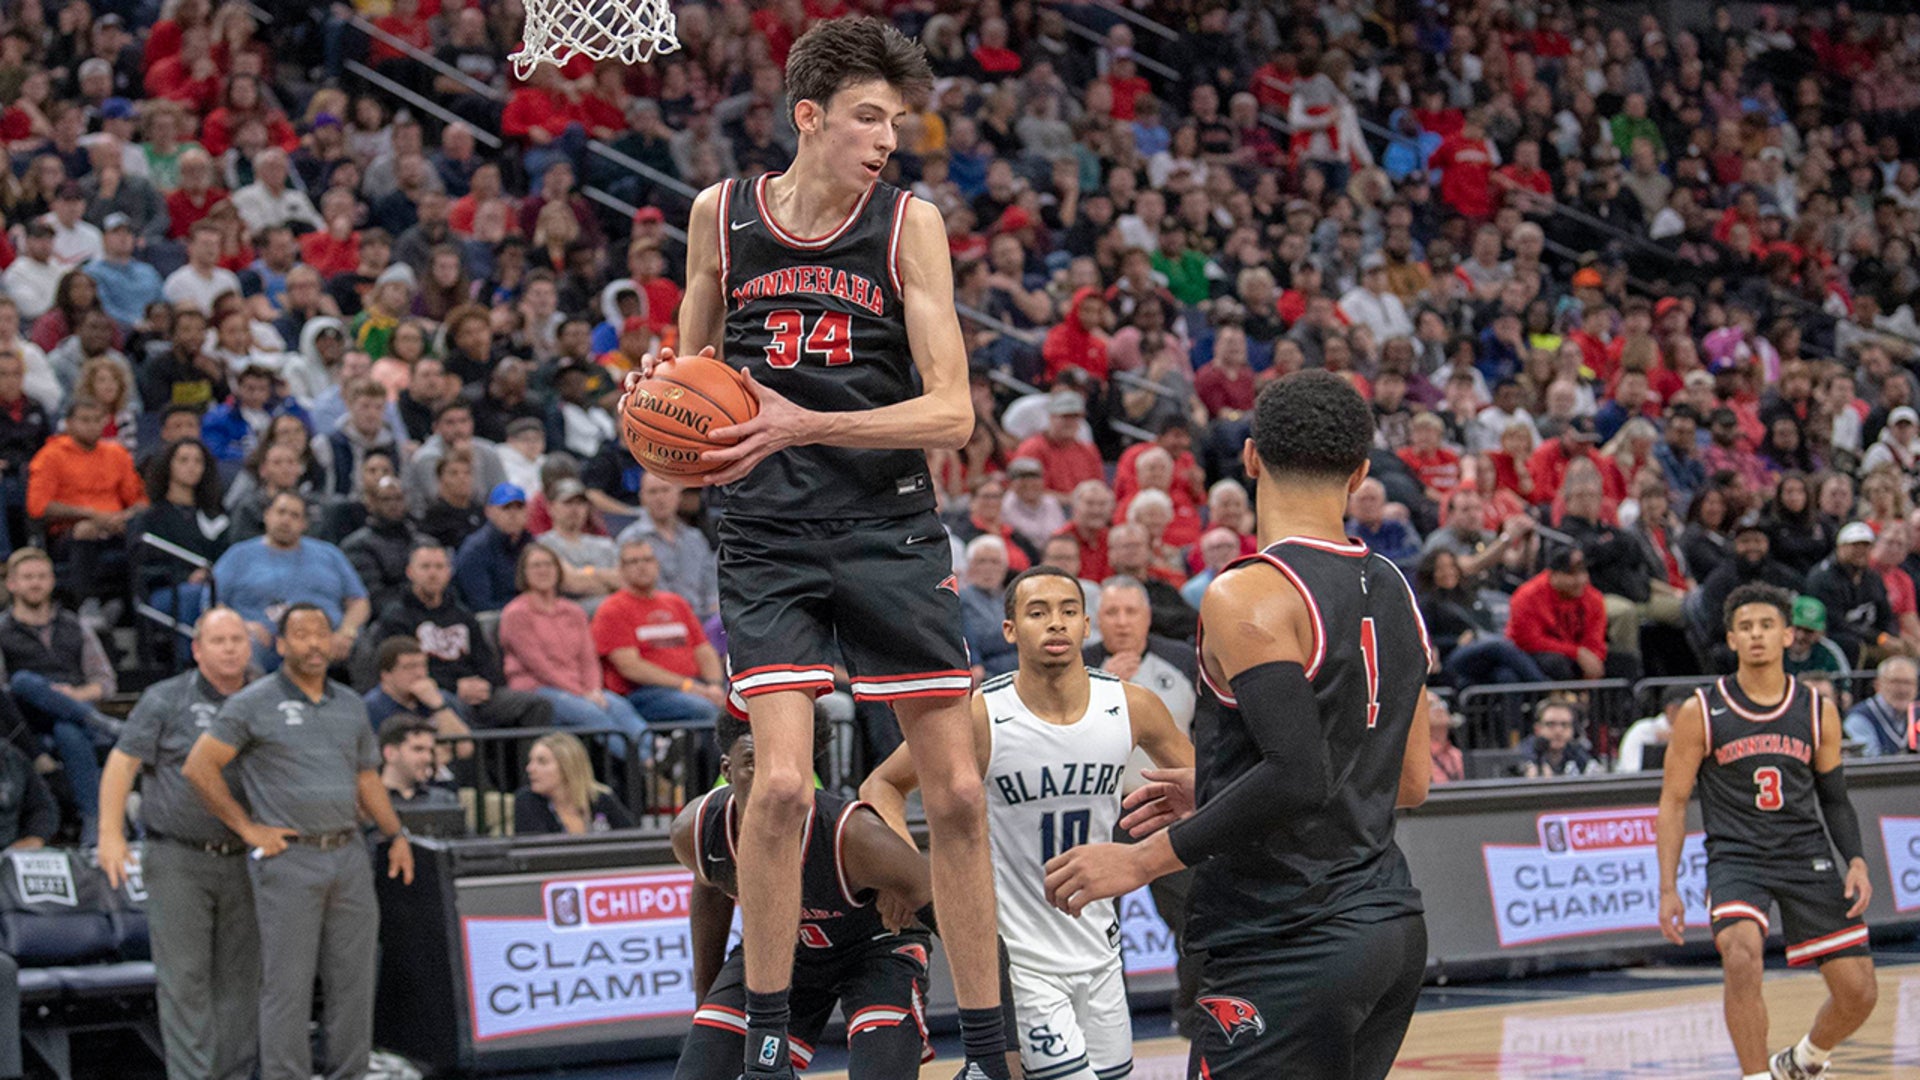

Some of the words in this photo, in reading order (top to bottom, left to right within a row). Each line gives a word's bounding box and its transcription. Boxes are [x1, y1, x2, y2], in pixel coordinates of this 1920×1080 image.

[732, 265, 885, 316] MINNEHAHA
[763, 309, 854, 369] 34
[647, 442, 700, 463] 1000
[1360, 617, 1381, 729] 1
[1715, 733, 1812, 766] MINNEHAHA
[994, 762, 1126, 806] BLAZERS
[1753, 766, 1785, 811] 3
[1039, 808, 1092, 867] 10
[1514, 860, 1648, 891] CLASH
[588, 885, 692, 918] CHIPOT
[505, 933, 689, 971] CLASH
[1028, 1024, 1069, 1058] SC
